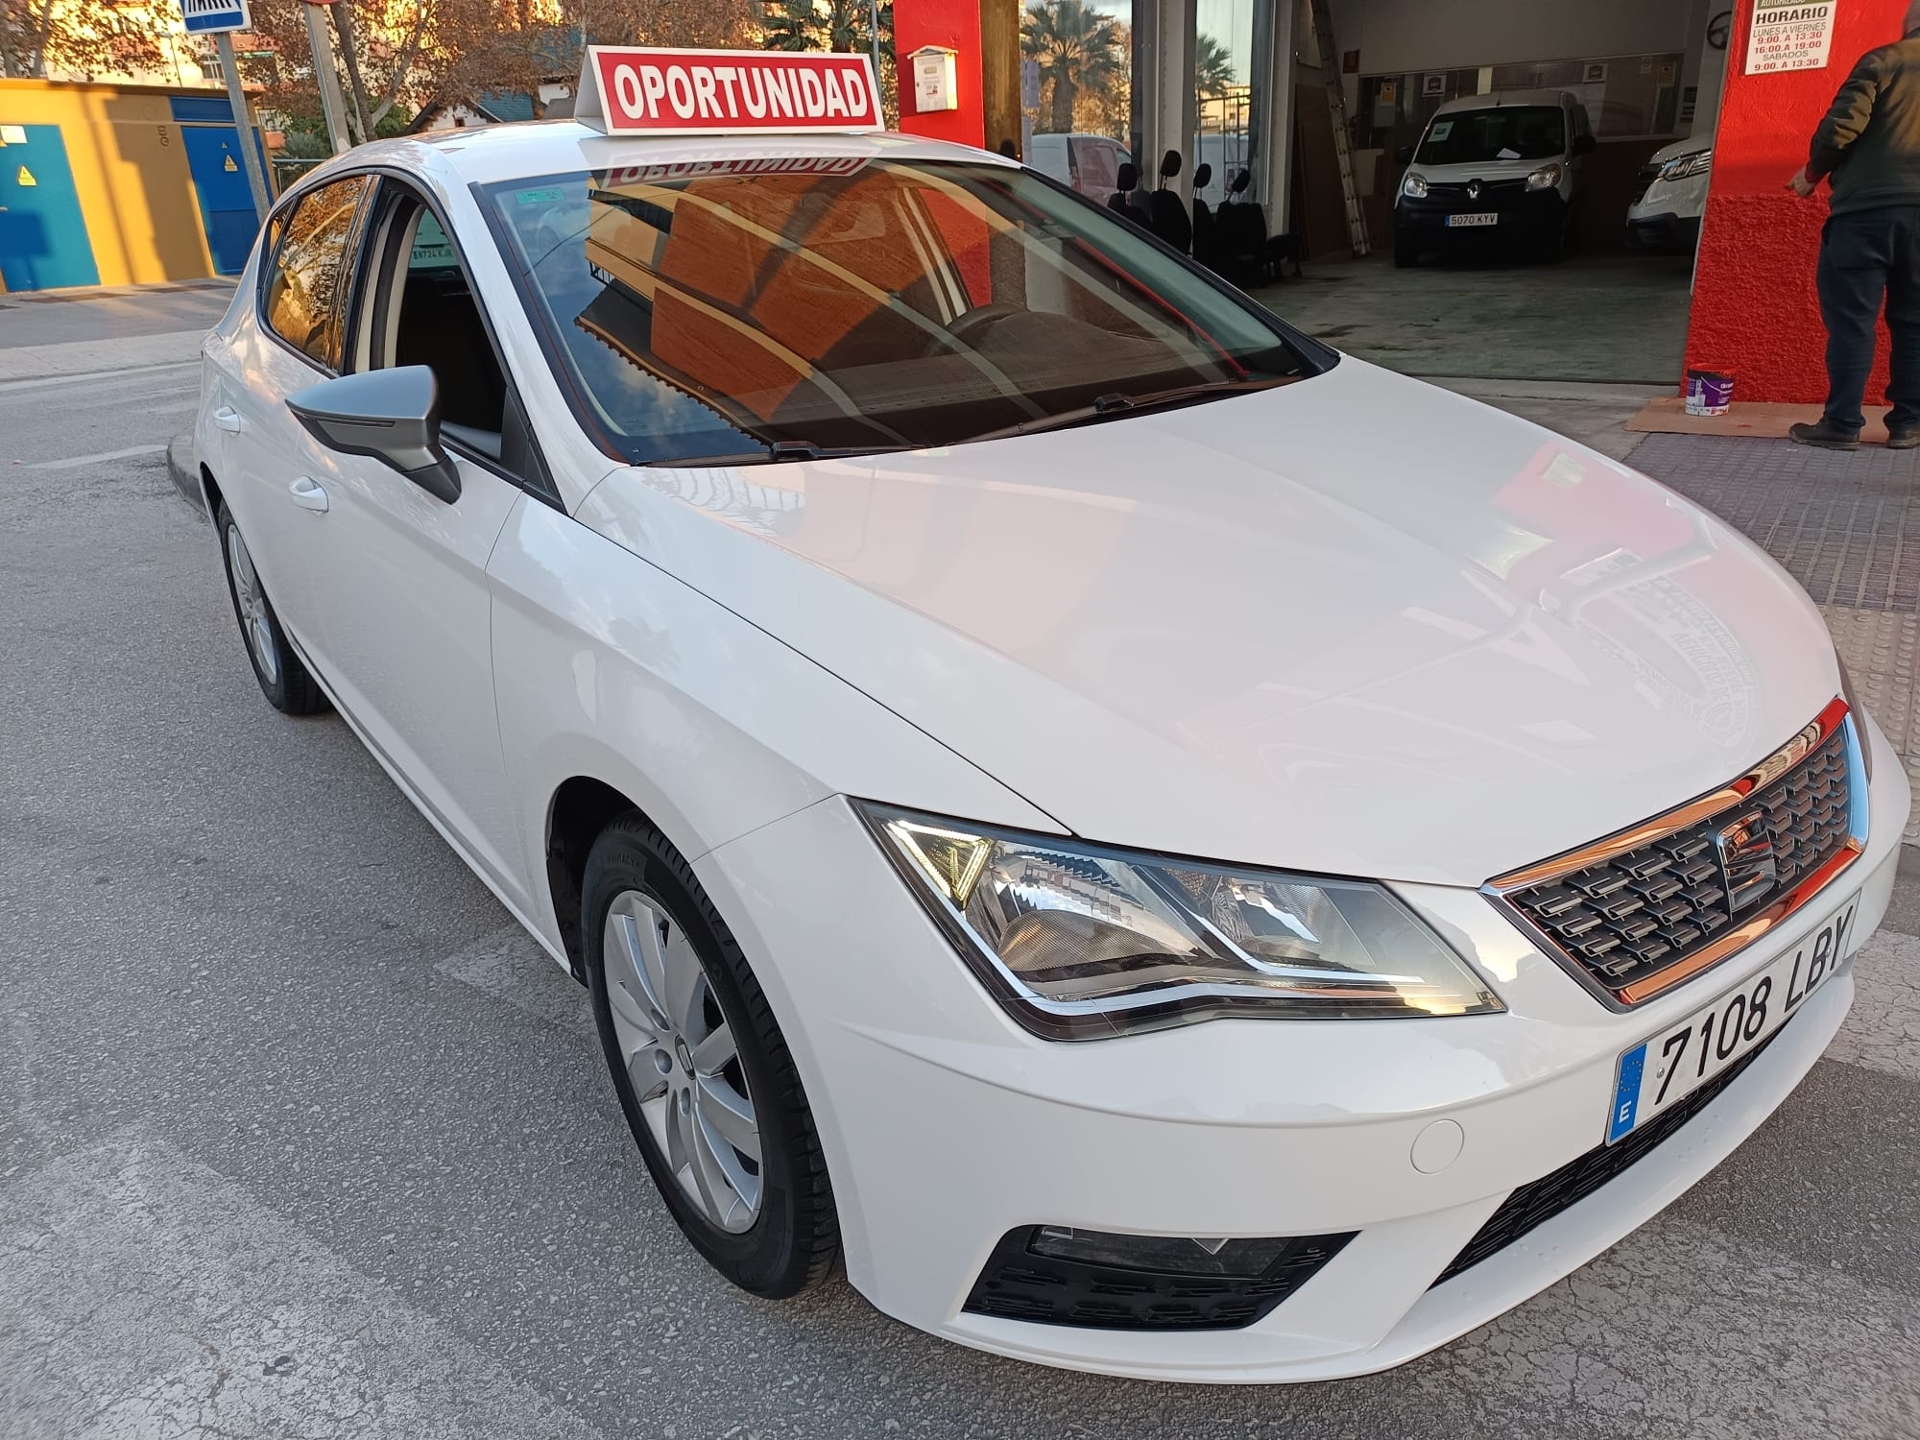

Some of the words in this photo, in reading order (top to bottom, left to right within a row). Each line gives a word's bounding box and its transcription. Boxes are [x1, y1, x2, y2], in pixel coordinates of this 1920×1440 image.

[1756, 6, 1828, 24] HORARIO
[1753, 27, 1781, 38] LUNES
[1782, 27, 1788, 35] A
[1789, 22, 1827, 34] VIERNES
[1784, 34, 1791, 42] A
[1795, 31, 1823, 41] 13:30
[1783, 44, 1790, 53] A
[1794, 40, 1822, 51] 19:00
[1763, 50, 1809, 61] SABADOS
[1781, 61, 1788, 69] A
[1792, 58, 1819, 68] 13:30
[613, 63, 868, 120] OPORTUNIDAD
[1451, 215, 1475, 225] 5070
[1477, 214, 1495, 224] KYV
[1654, 976, 1772, 1106] 7108
[1784, 904, 1854, 1014] LBY
[1618, 1100, 1632, 1123] E
